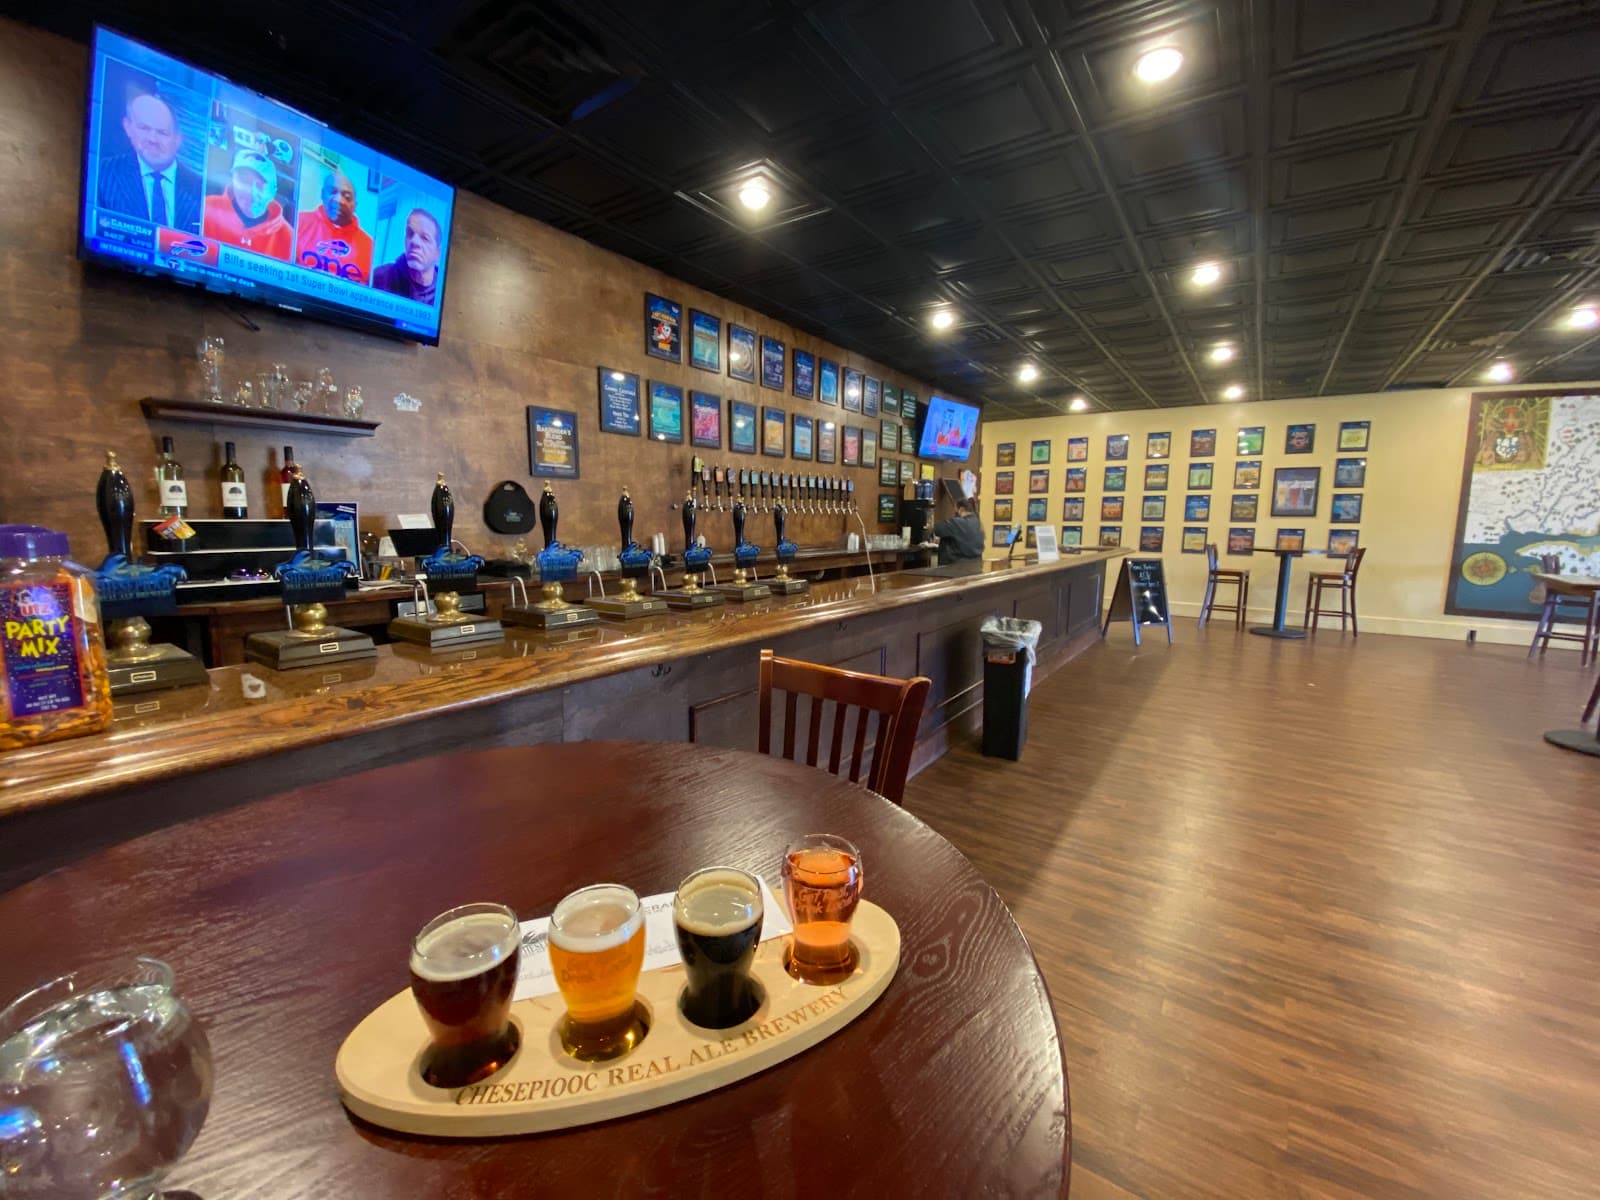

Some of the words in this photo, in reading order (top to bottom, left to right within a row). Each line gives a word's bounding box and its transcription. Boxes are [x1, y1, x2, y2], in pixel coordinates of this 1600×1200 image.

[224, 252, 244, 268] Bills
[247, 261, 284, 281] seeking
[286, 271, 299, 282] 1st
[302, 275, 326, 291] Super
[328, 283, 348, 297] Bowl
[350, 290, 394, 312] appearance
[395, 303, 413, 315] since
[5, 614, 70, 641] PARTY
[20, 636, 60, 659] MIX
[455, 1072, 598, 1106] CHESEPIOOC
[608, 1056, 681, 1087] REAL
[689, 1038, 739, 1066] ALE
[743, 986, 849, 1046] BREWERY
